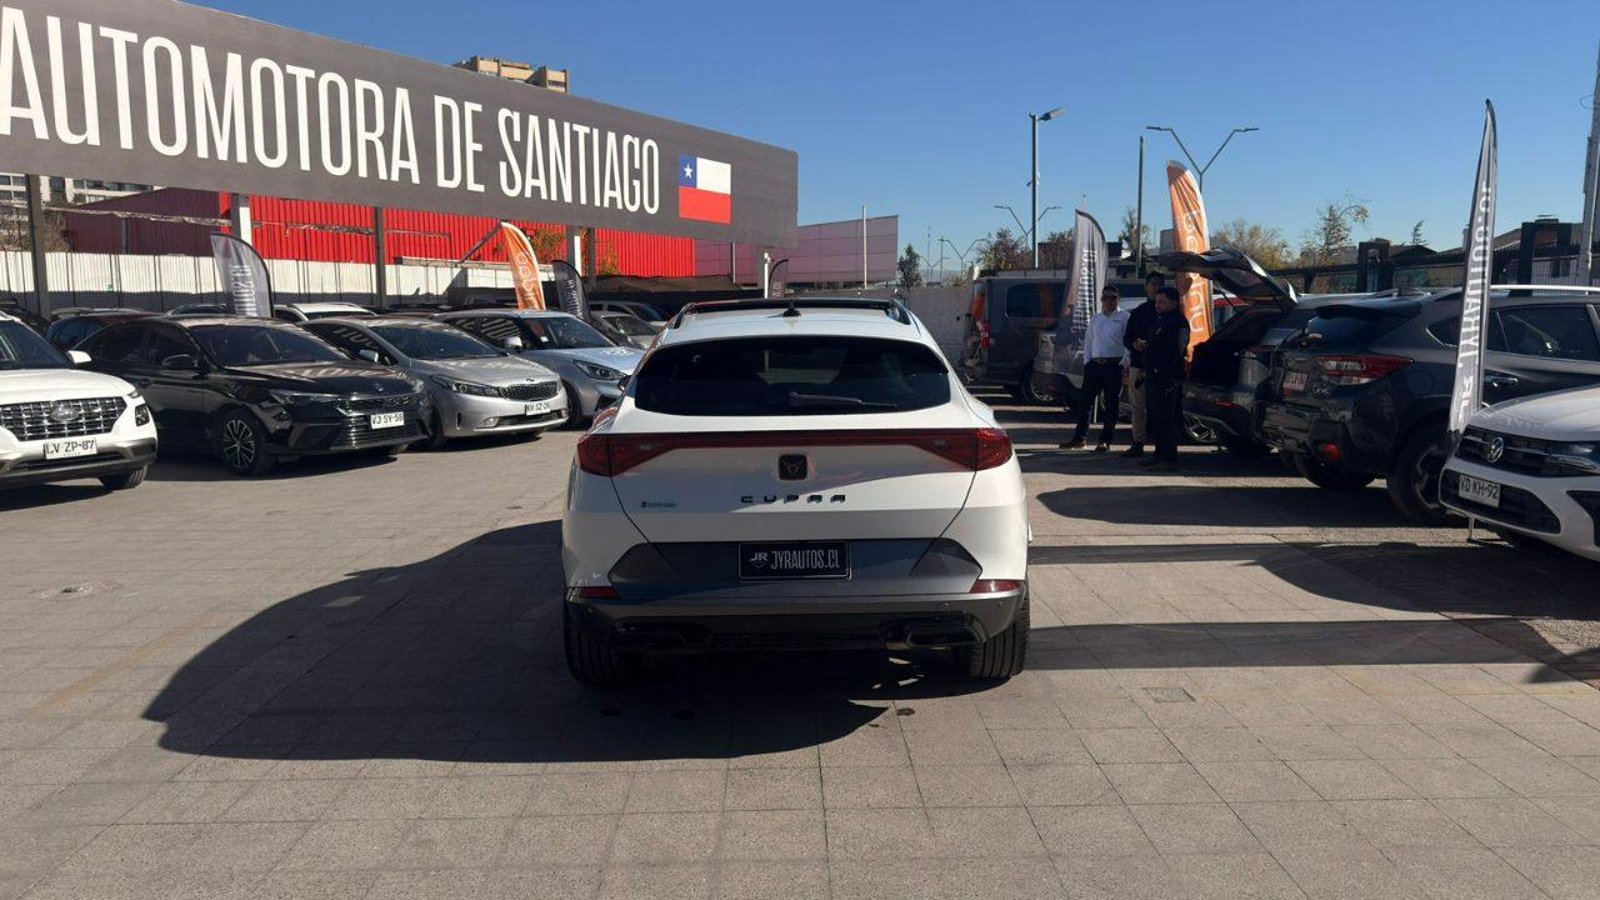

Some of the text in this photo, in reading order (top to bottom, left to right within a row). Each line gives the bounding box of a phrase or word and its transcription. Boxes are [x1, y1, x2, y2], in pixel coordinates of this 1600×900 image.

[0, 6, 660, 215] AUTOMOTORA DE SANTIAGO
[46, 443, 60, 454] LV
[741, 494, 846, 504] CUPRA
[770, 549, 841, 570] JYRAUTOS.CL
